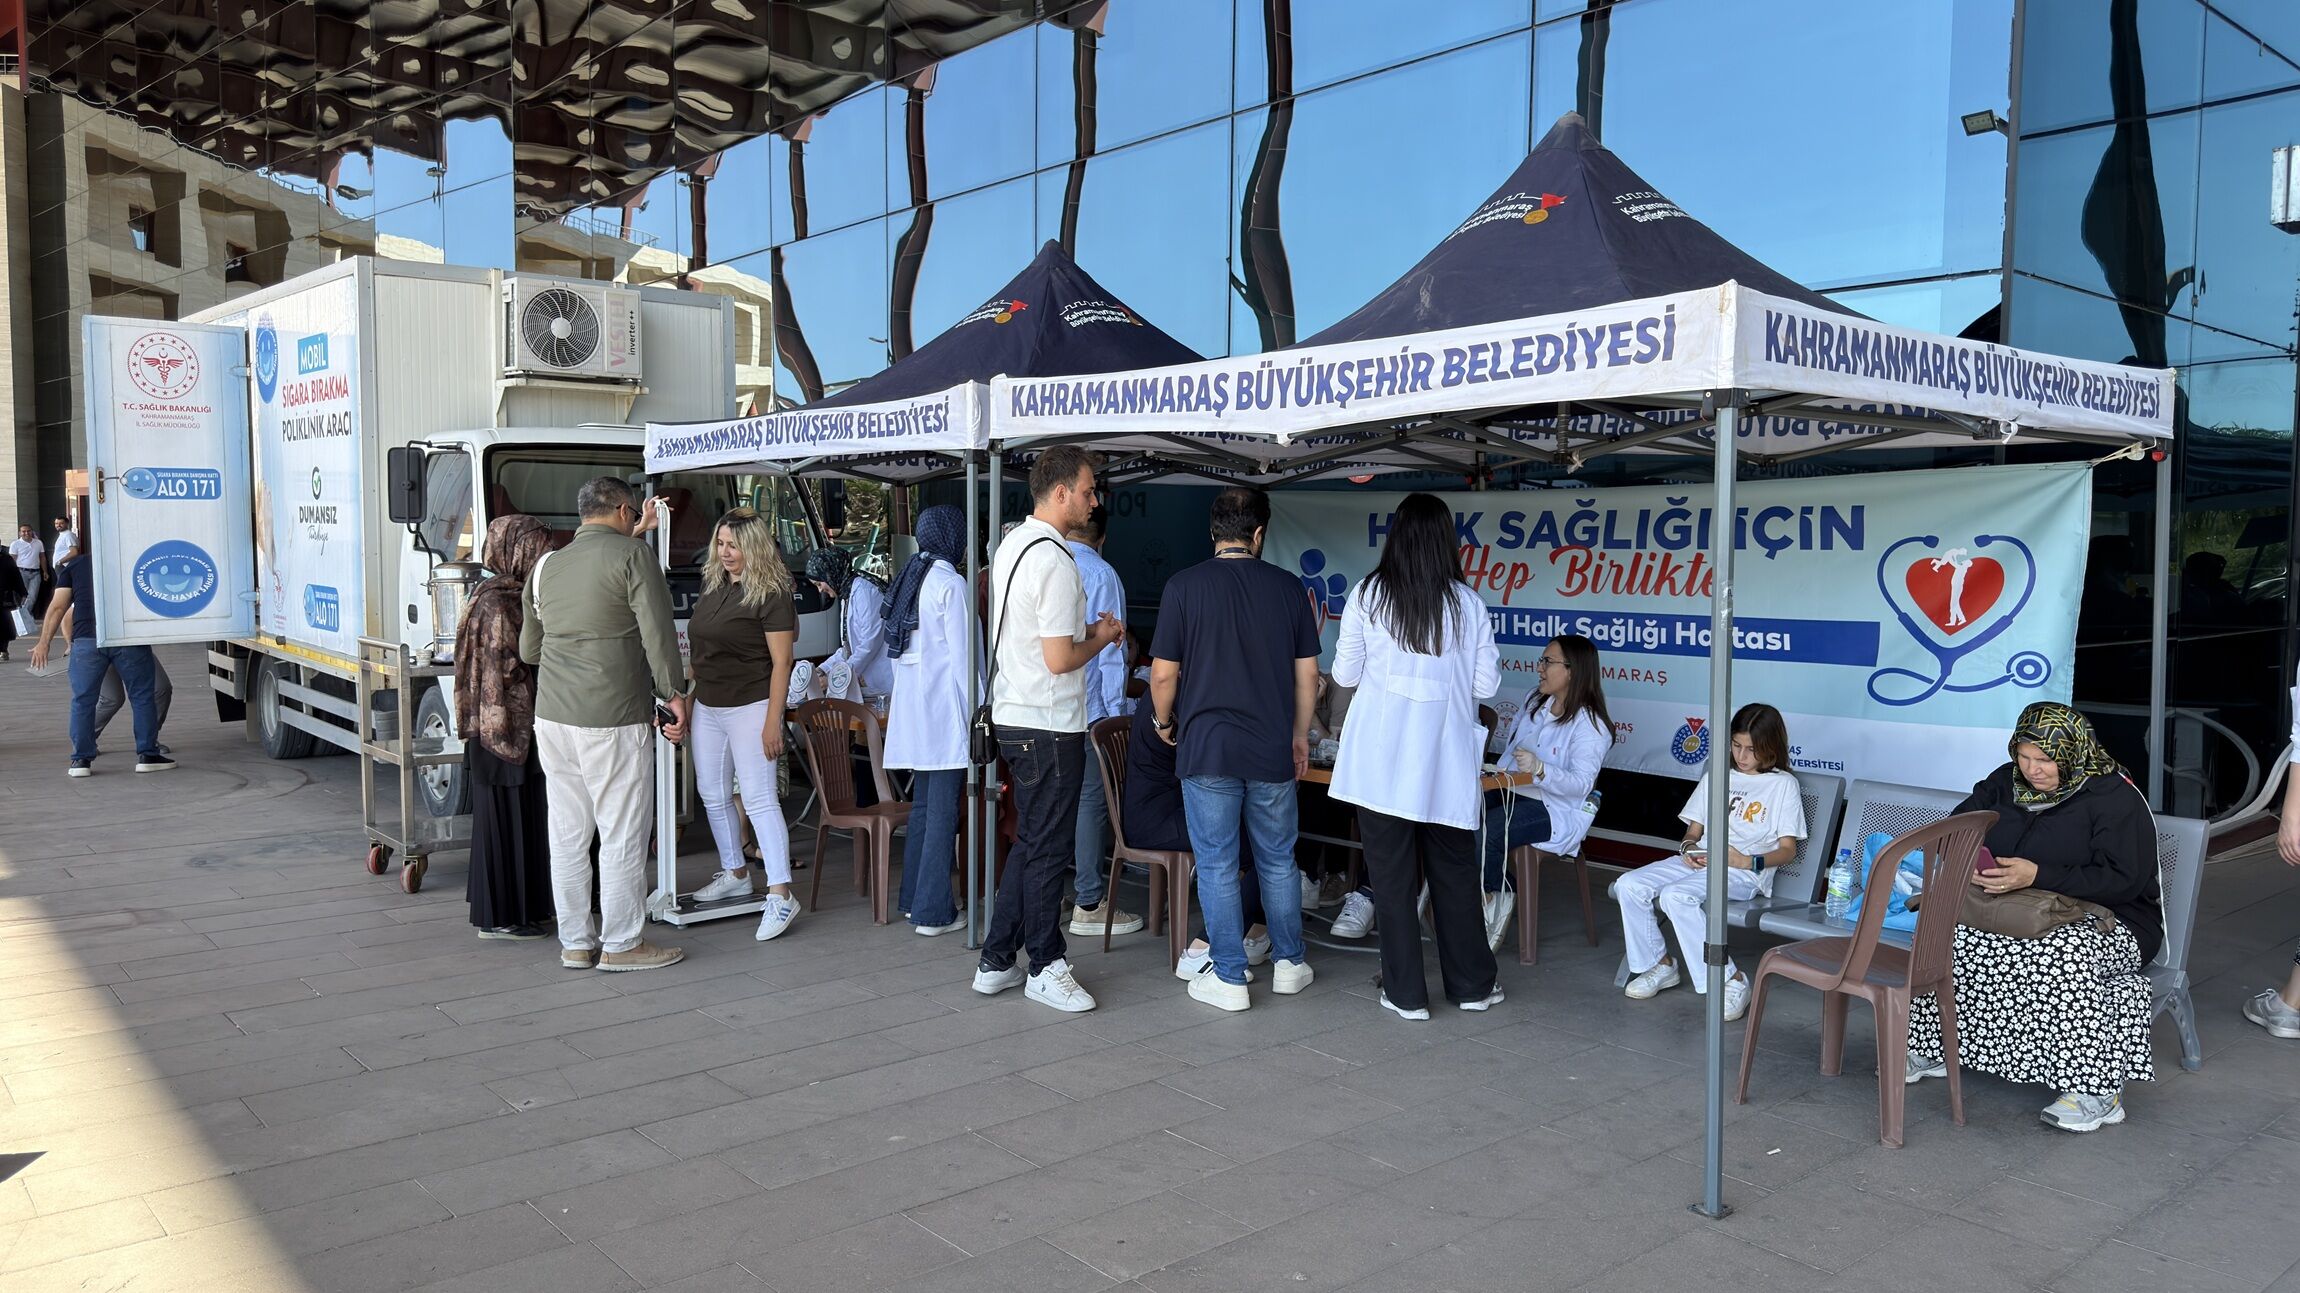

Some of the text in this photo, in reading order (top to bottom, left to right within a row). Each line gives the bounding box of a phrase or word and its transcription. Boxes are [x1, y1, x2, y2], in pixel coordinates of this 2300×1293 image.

[301, 338, 326, 371] MOBİL
[1011, 303, 1677, 418] KAHRAMANMARAŞ BÜYÜKŞEHİR BELEDİYESİ
[1765, 309, 2161, 420] KAHRAMANMARAŞ BÜYÜKŞEHİR BELEDİYESİ
[282, 374, 349, 408] SİGARA BIRAKMA
[122, 403, 212, 413] T.C. SAĞLIK BAKANLIĞI
[766, 411, 854, 447] BÜYÜKŞEHİR
[858, 395, 950, 440] BELEDİYESİ
[282, 409, 352, 442] POLİKLİNİK ARACI
[158, 479, 215, 496] ALO 171
[299, 506, 337, 524] DUMANSIZ
[1368, 496, 1865, 560] HK SAĞLIĞI İÇİN
[136, 575, 168, 600] DUMANSIZ
[171, 590, 200, 600] HAVA
[1458, 544, 1536, 606] Hep
[315, 601, 326, 626] ALO
[327, 602, 338, 628] 171
[1513, 614, 1567, 637] Halk
[1575, 616, 1667, 650] Sağlığı
[1675, 622, 1791, 651] Hatası
[1790, 758, 1844, 771] VERSİTESİ
